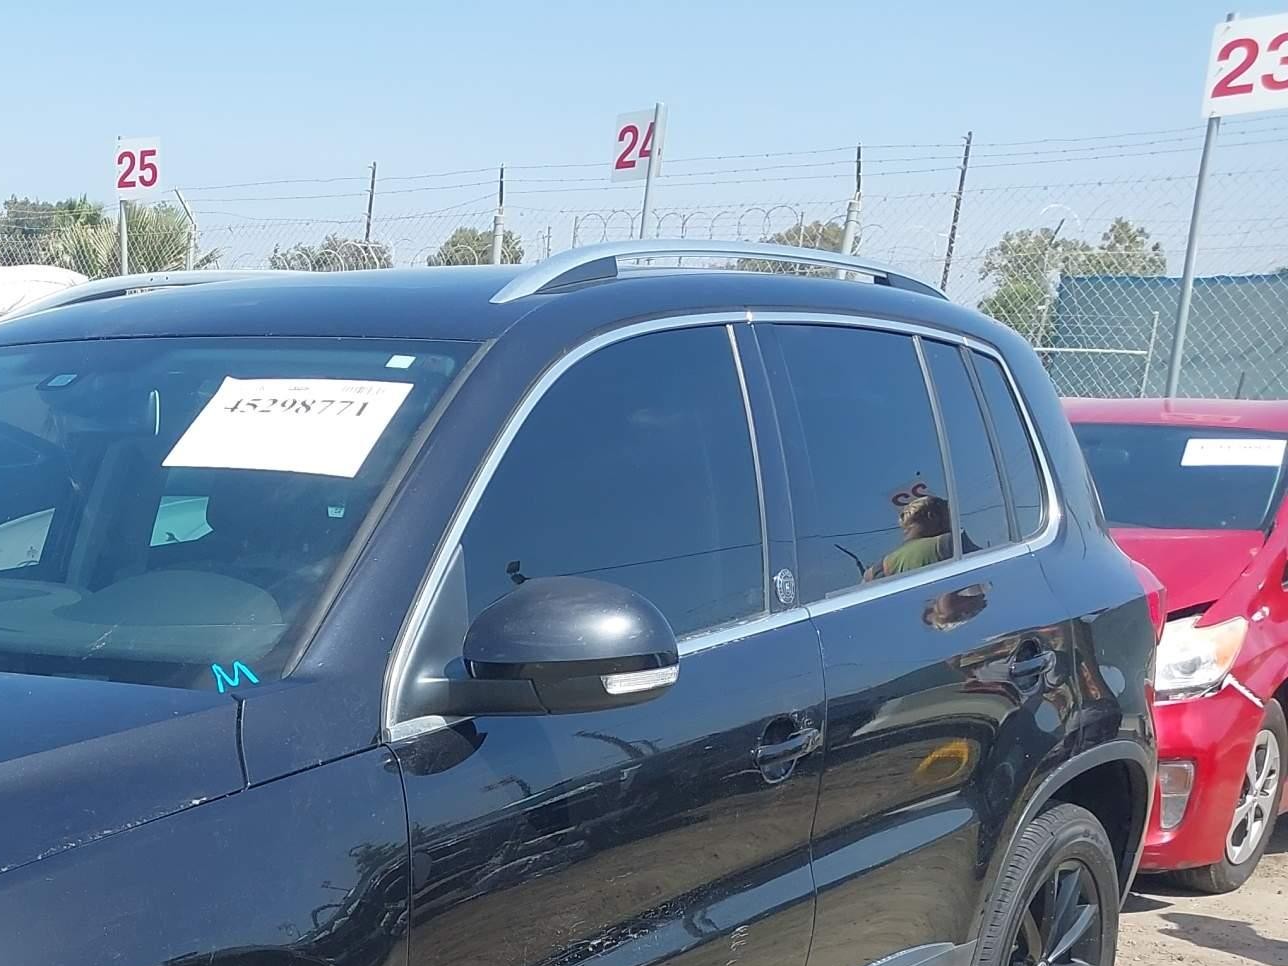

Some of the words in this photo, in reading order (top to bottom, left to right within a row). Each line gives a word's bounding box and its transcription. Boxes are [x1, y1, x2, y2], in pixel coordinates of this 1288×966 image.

[1211, 32, 1288, 98] 23
[118, 150, 157, 188] 25
[224, 398, 369, 417] 45298771
[211, 661, 260, 693] M
